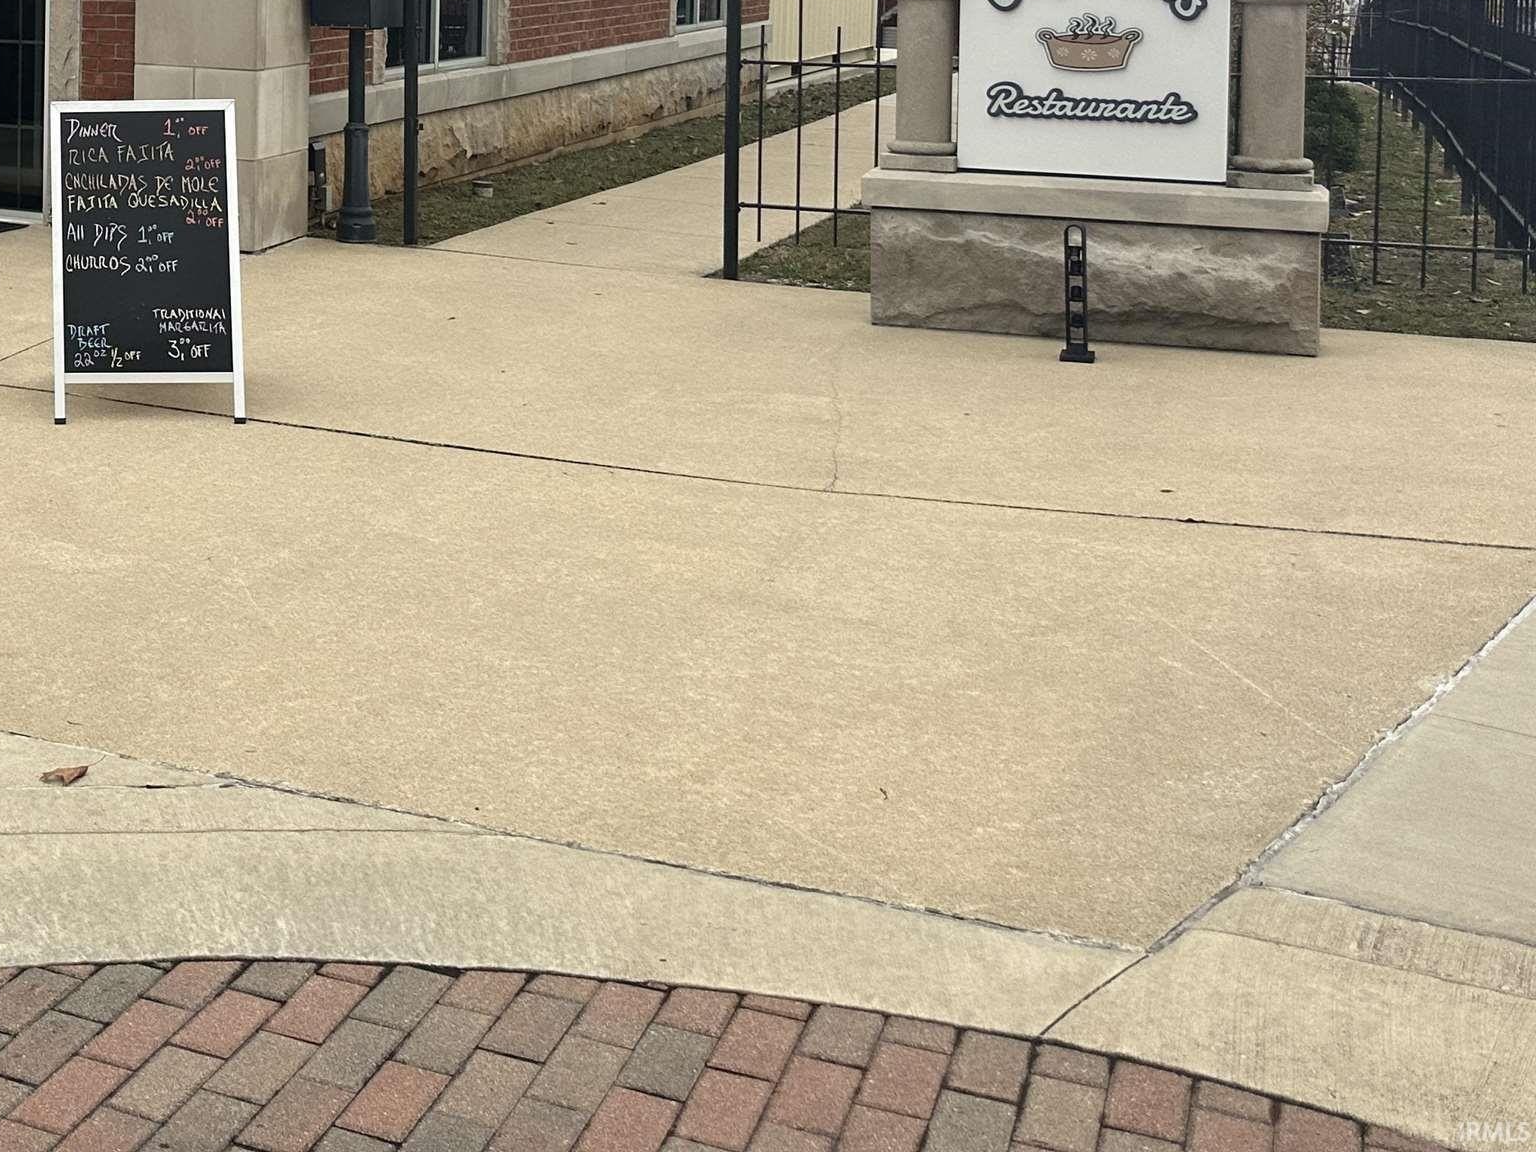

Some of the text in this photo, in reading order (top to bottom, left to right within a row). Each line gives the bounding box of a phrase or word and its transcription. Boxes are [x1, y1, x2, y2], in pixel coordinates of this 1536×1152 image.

[988, 84, 1195, 122] Restaurante
[65, 119, 123, 143] DINNER
[69, 141, 175, 165] RICA FAJITA
[182, 176, 219, 193] MOLE
[67, 193, 222, 213] FAJITA QUESADILLA
[94, 223, 128, 251] DIPS
[157, 232, 174, 244] OFF
[65, 254, 131, 276] CHURROS
[159, 260, 178, 272] OFF
[67, 323, 110, 340] DRAFT
[159, 320, 227, 335] MARGARITA
[77, 337, 112, 350] BEER
[190, 344, 211, 358] OFF
[124, 351, 142, 361] OFF
